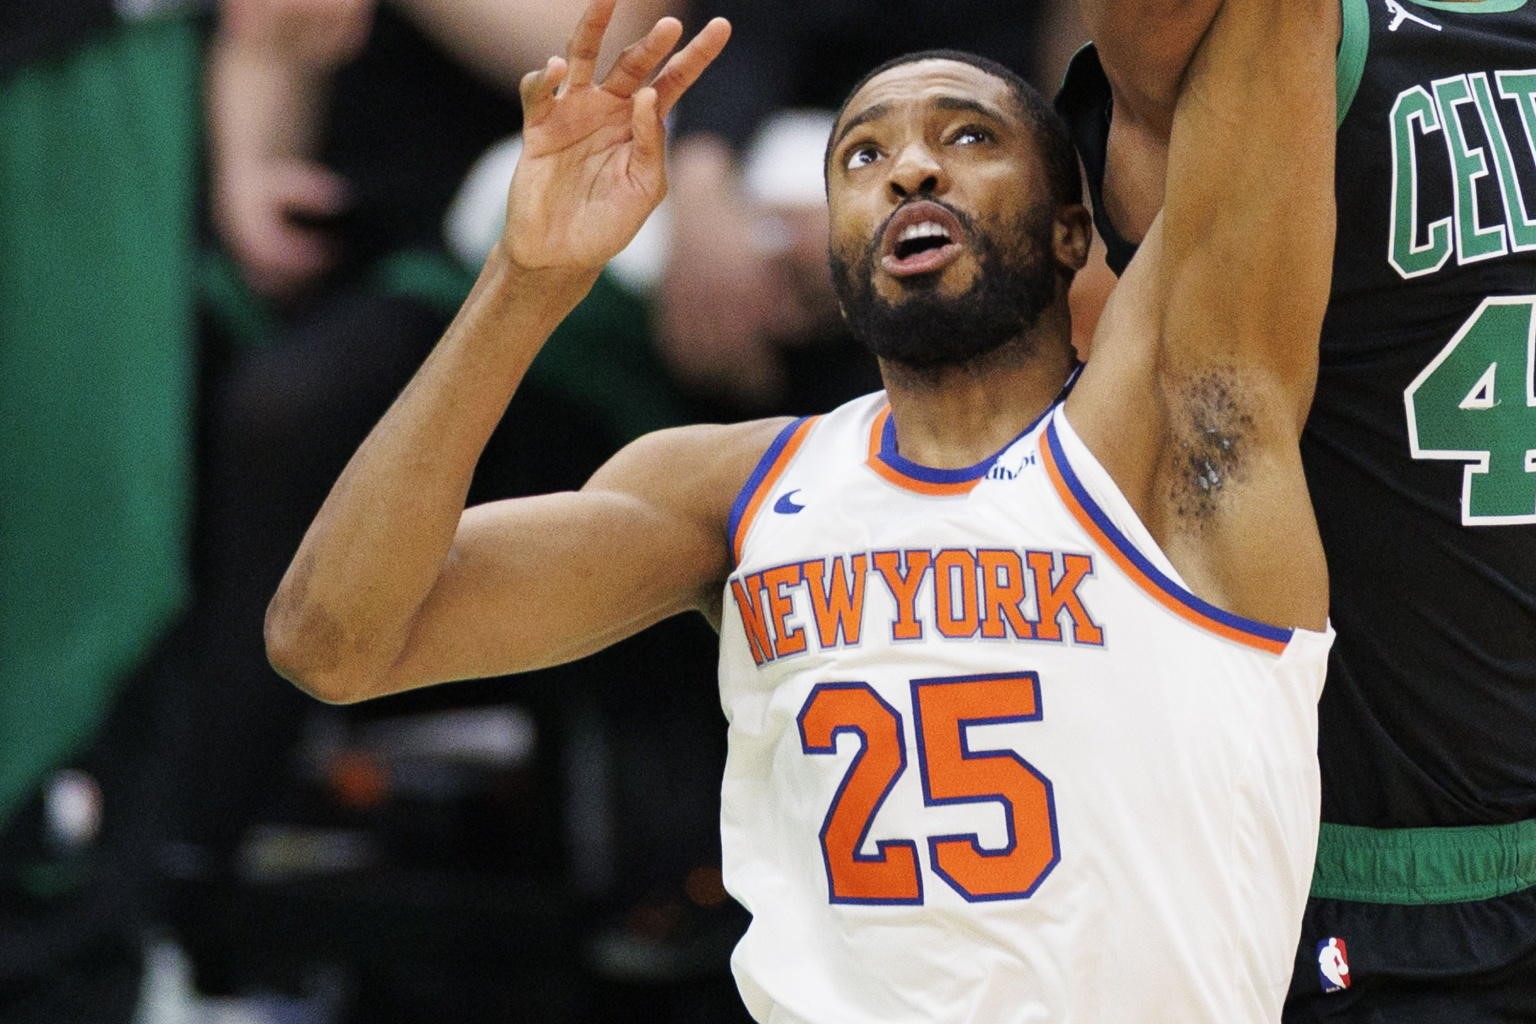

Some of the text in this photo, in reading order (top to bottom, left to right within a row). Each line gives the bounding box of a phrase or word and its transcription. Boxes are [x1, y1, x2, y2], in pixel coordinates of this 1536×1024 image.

[730, 545, 1109, 669] NEW YORK
[796, 670, 1062, 906] 25
